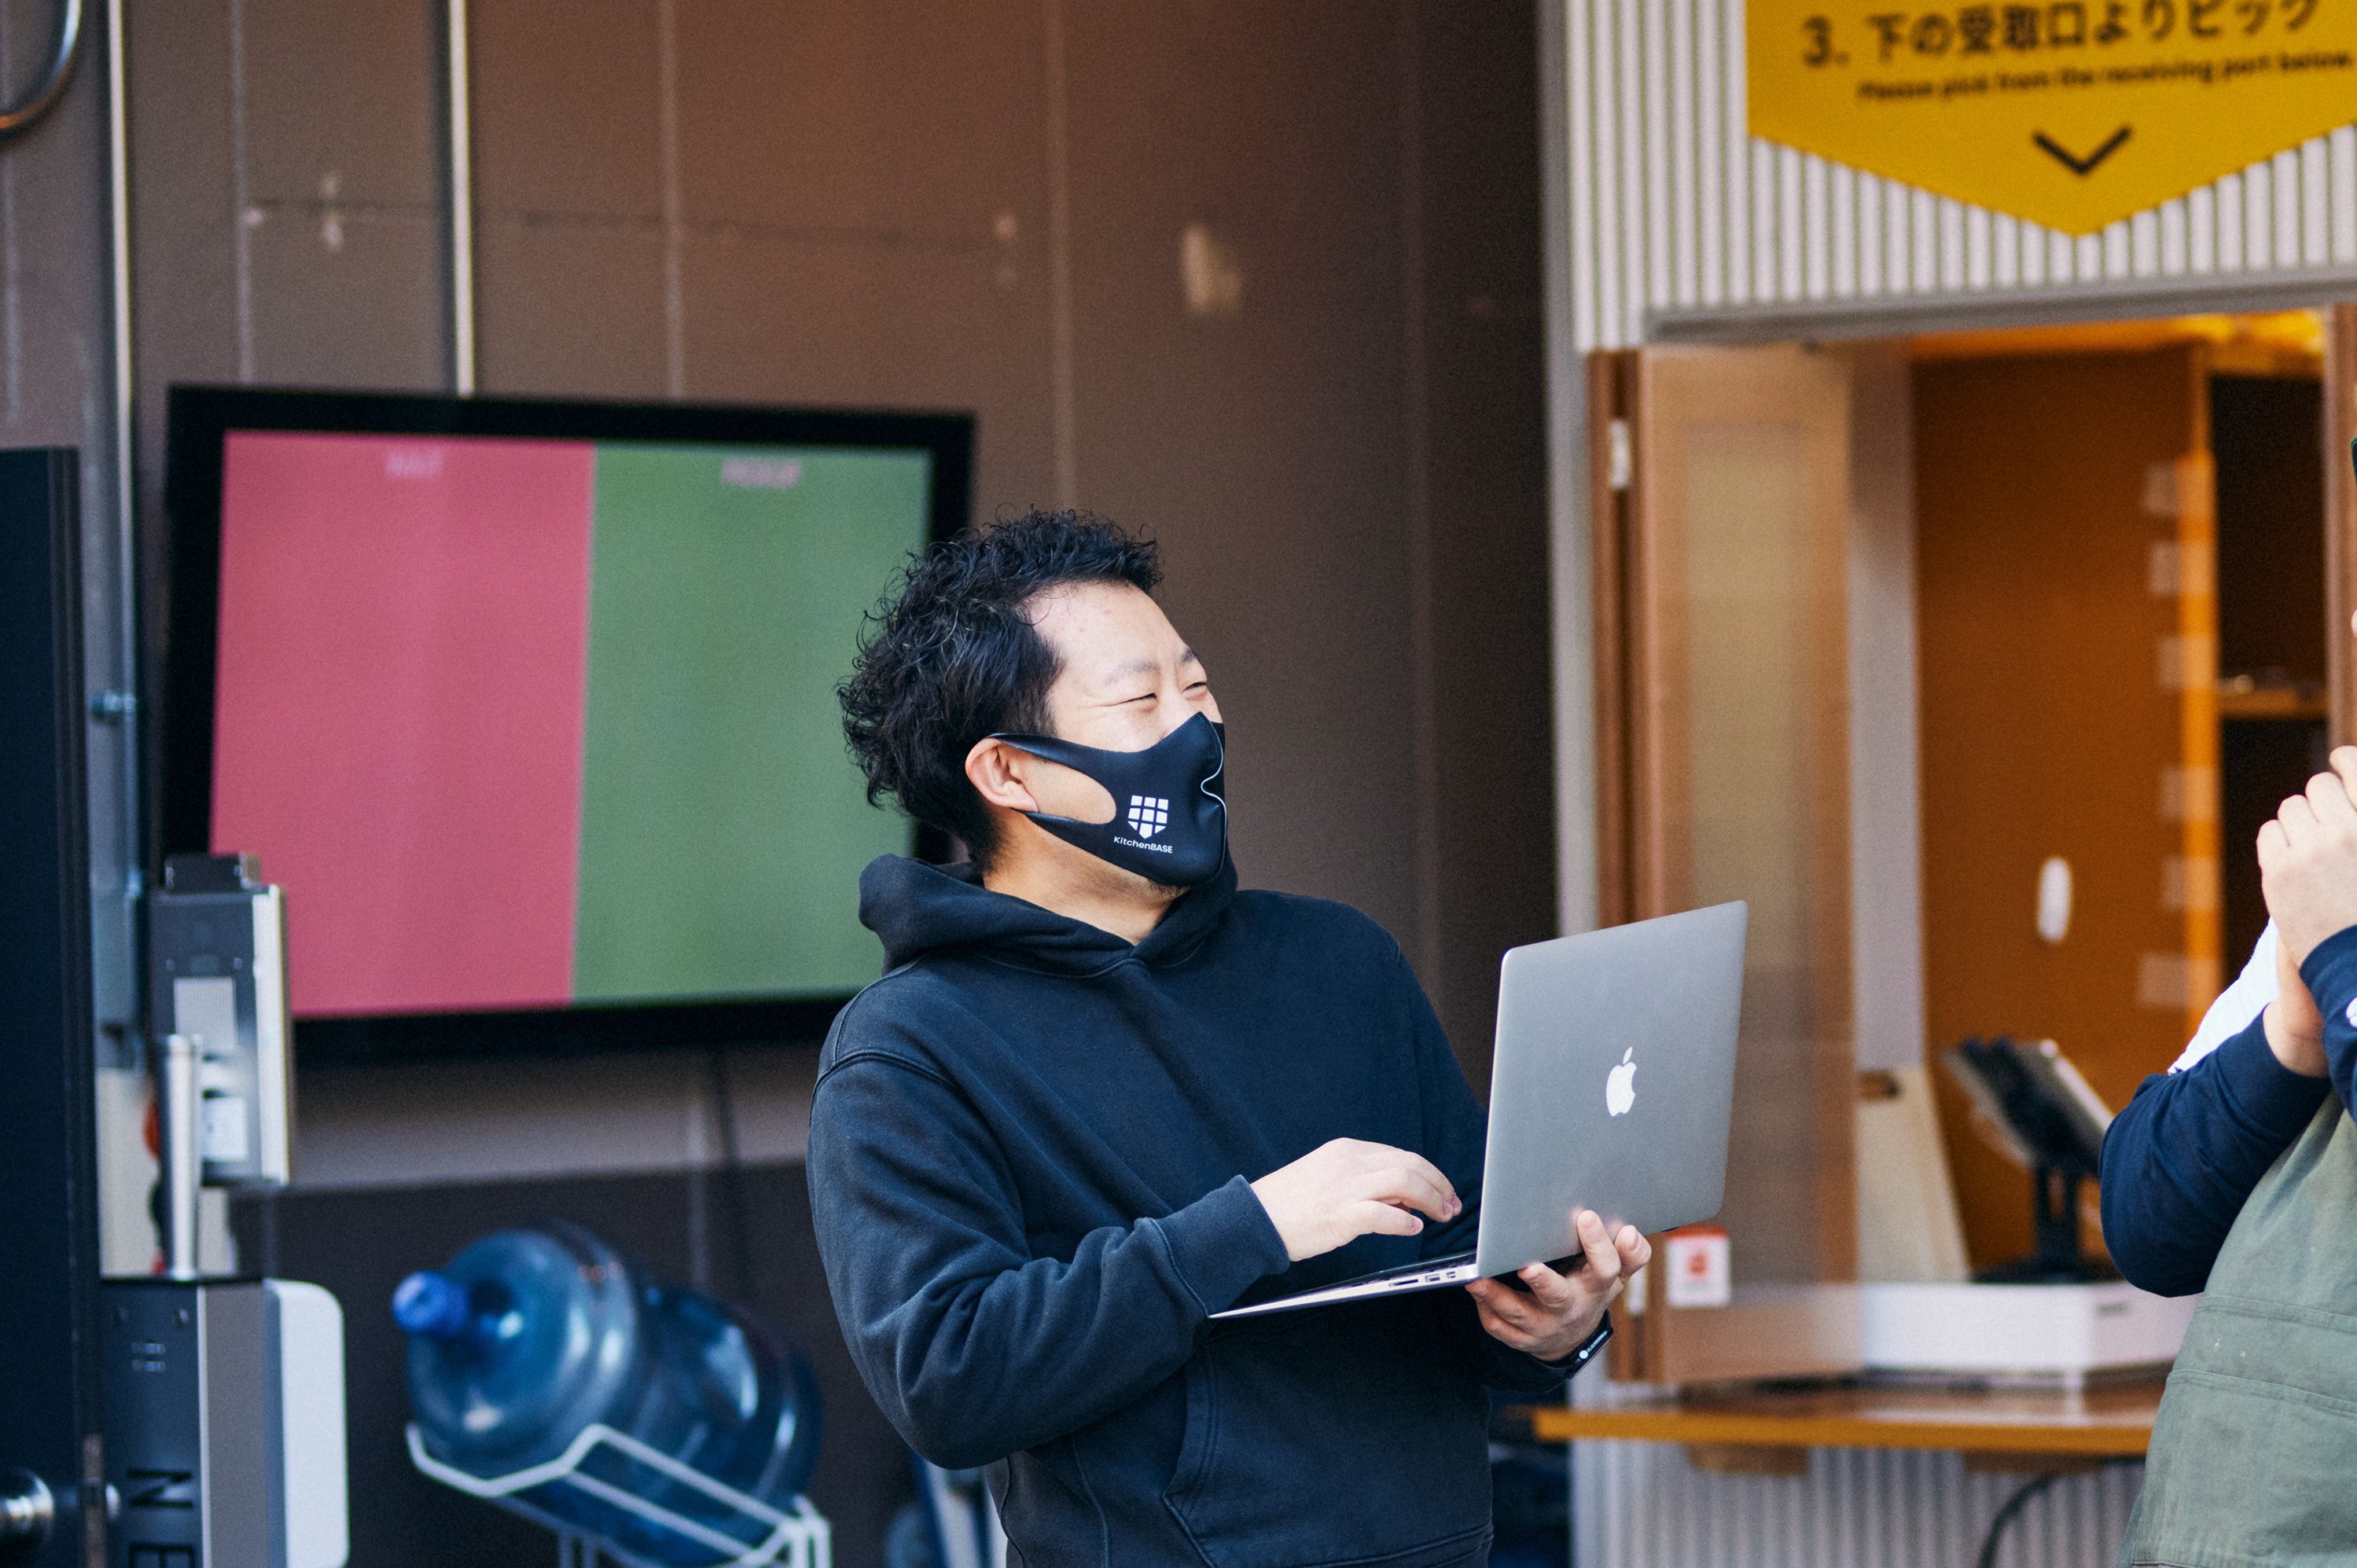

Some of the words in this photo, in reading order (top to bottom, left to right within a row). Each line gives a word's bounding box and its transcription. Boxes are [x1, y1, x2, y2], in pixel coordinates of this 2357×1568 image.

[1803, 14, 1851, 68] 3.
[1942, 77, 1989, 101] pick
[1998, 73, 2049, 90] from
[2058, 68, 2094, 86] the
[1113, 835, 1173, 854] KitchenBASE
